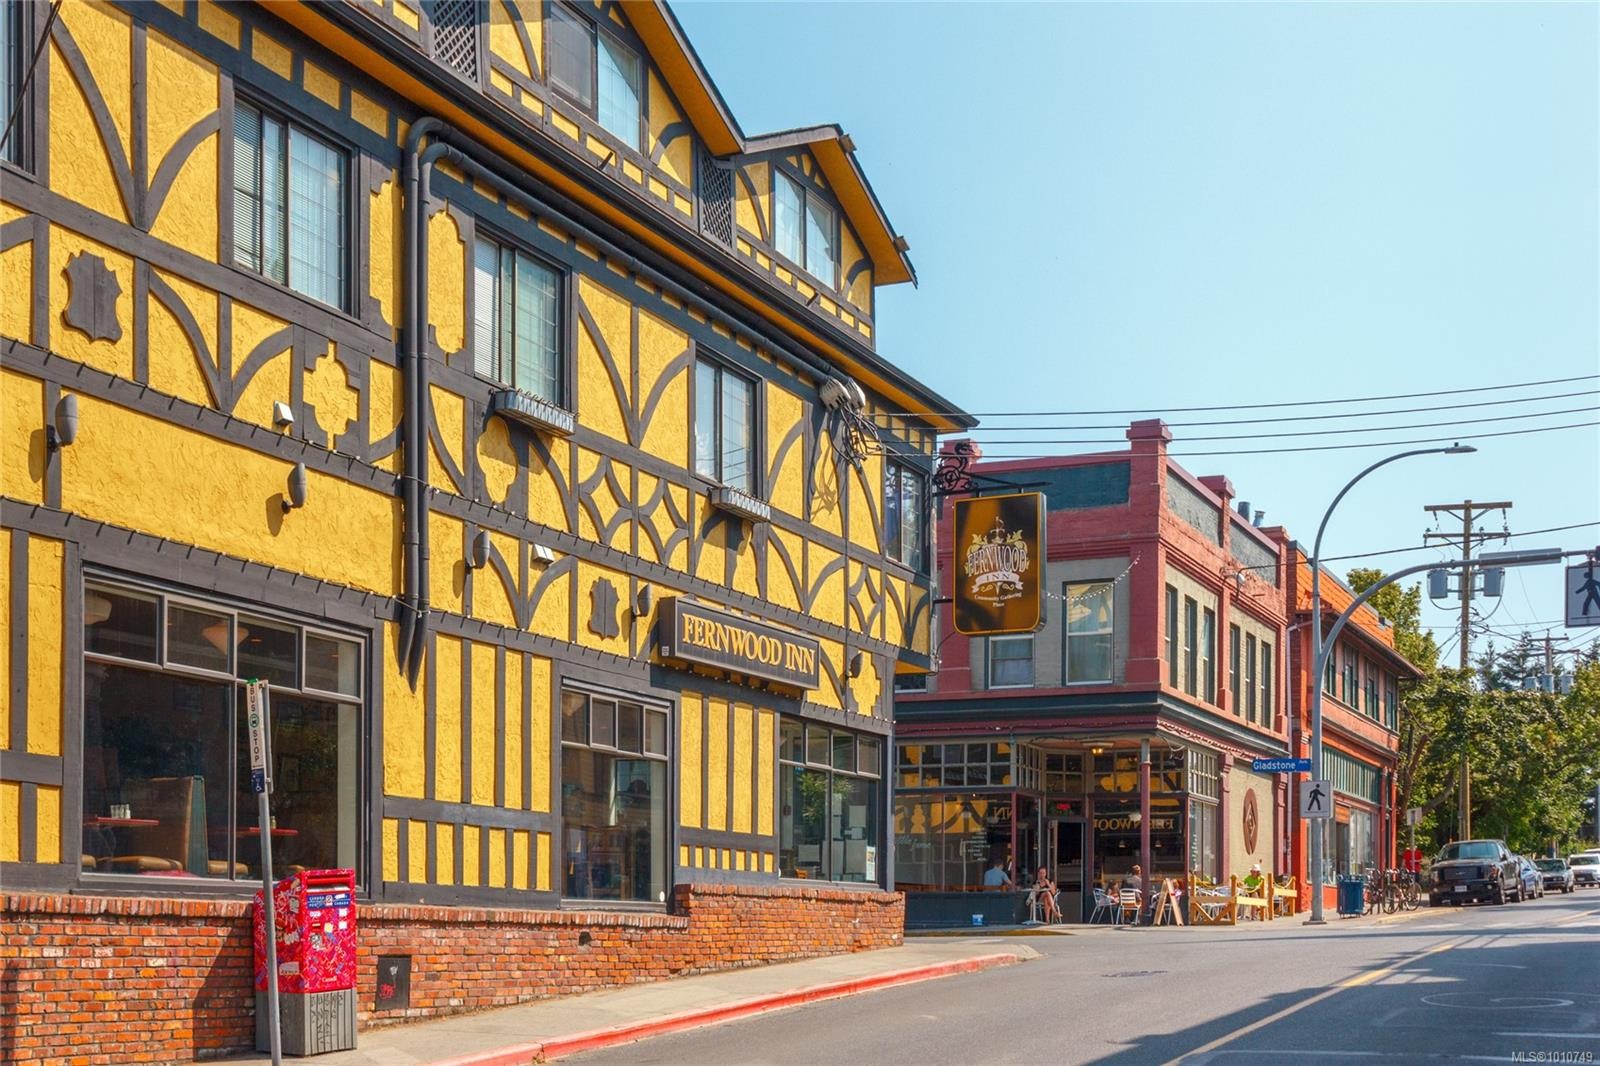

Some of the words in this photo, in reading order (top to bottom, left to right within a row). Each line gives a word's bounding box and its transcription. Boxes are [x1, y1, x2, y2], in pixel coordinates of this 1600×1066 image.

[967, 543, 1027, 577] FERNWOOD
[986, 573, 1010, 581] INN
[682, 613, 783, 666] FERNWOOD
[784, 642, 816, 675] INN
[252, 729, 260, 762] STOP
[1253, 760, 1296, 770] Gladstone
